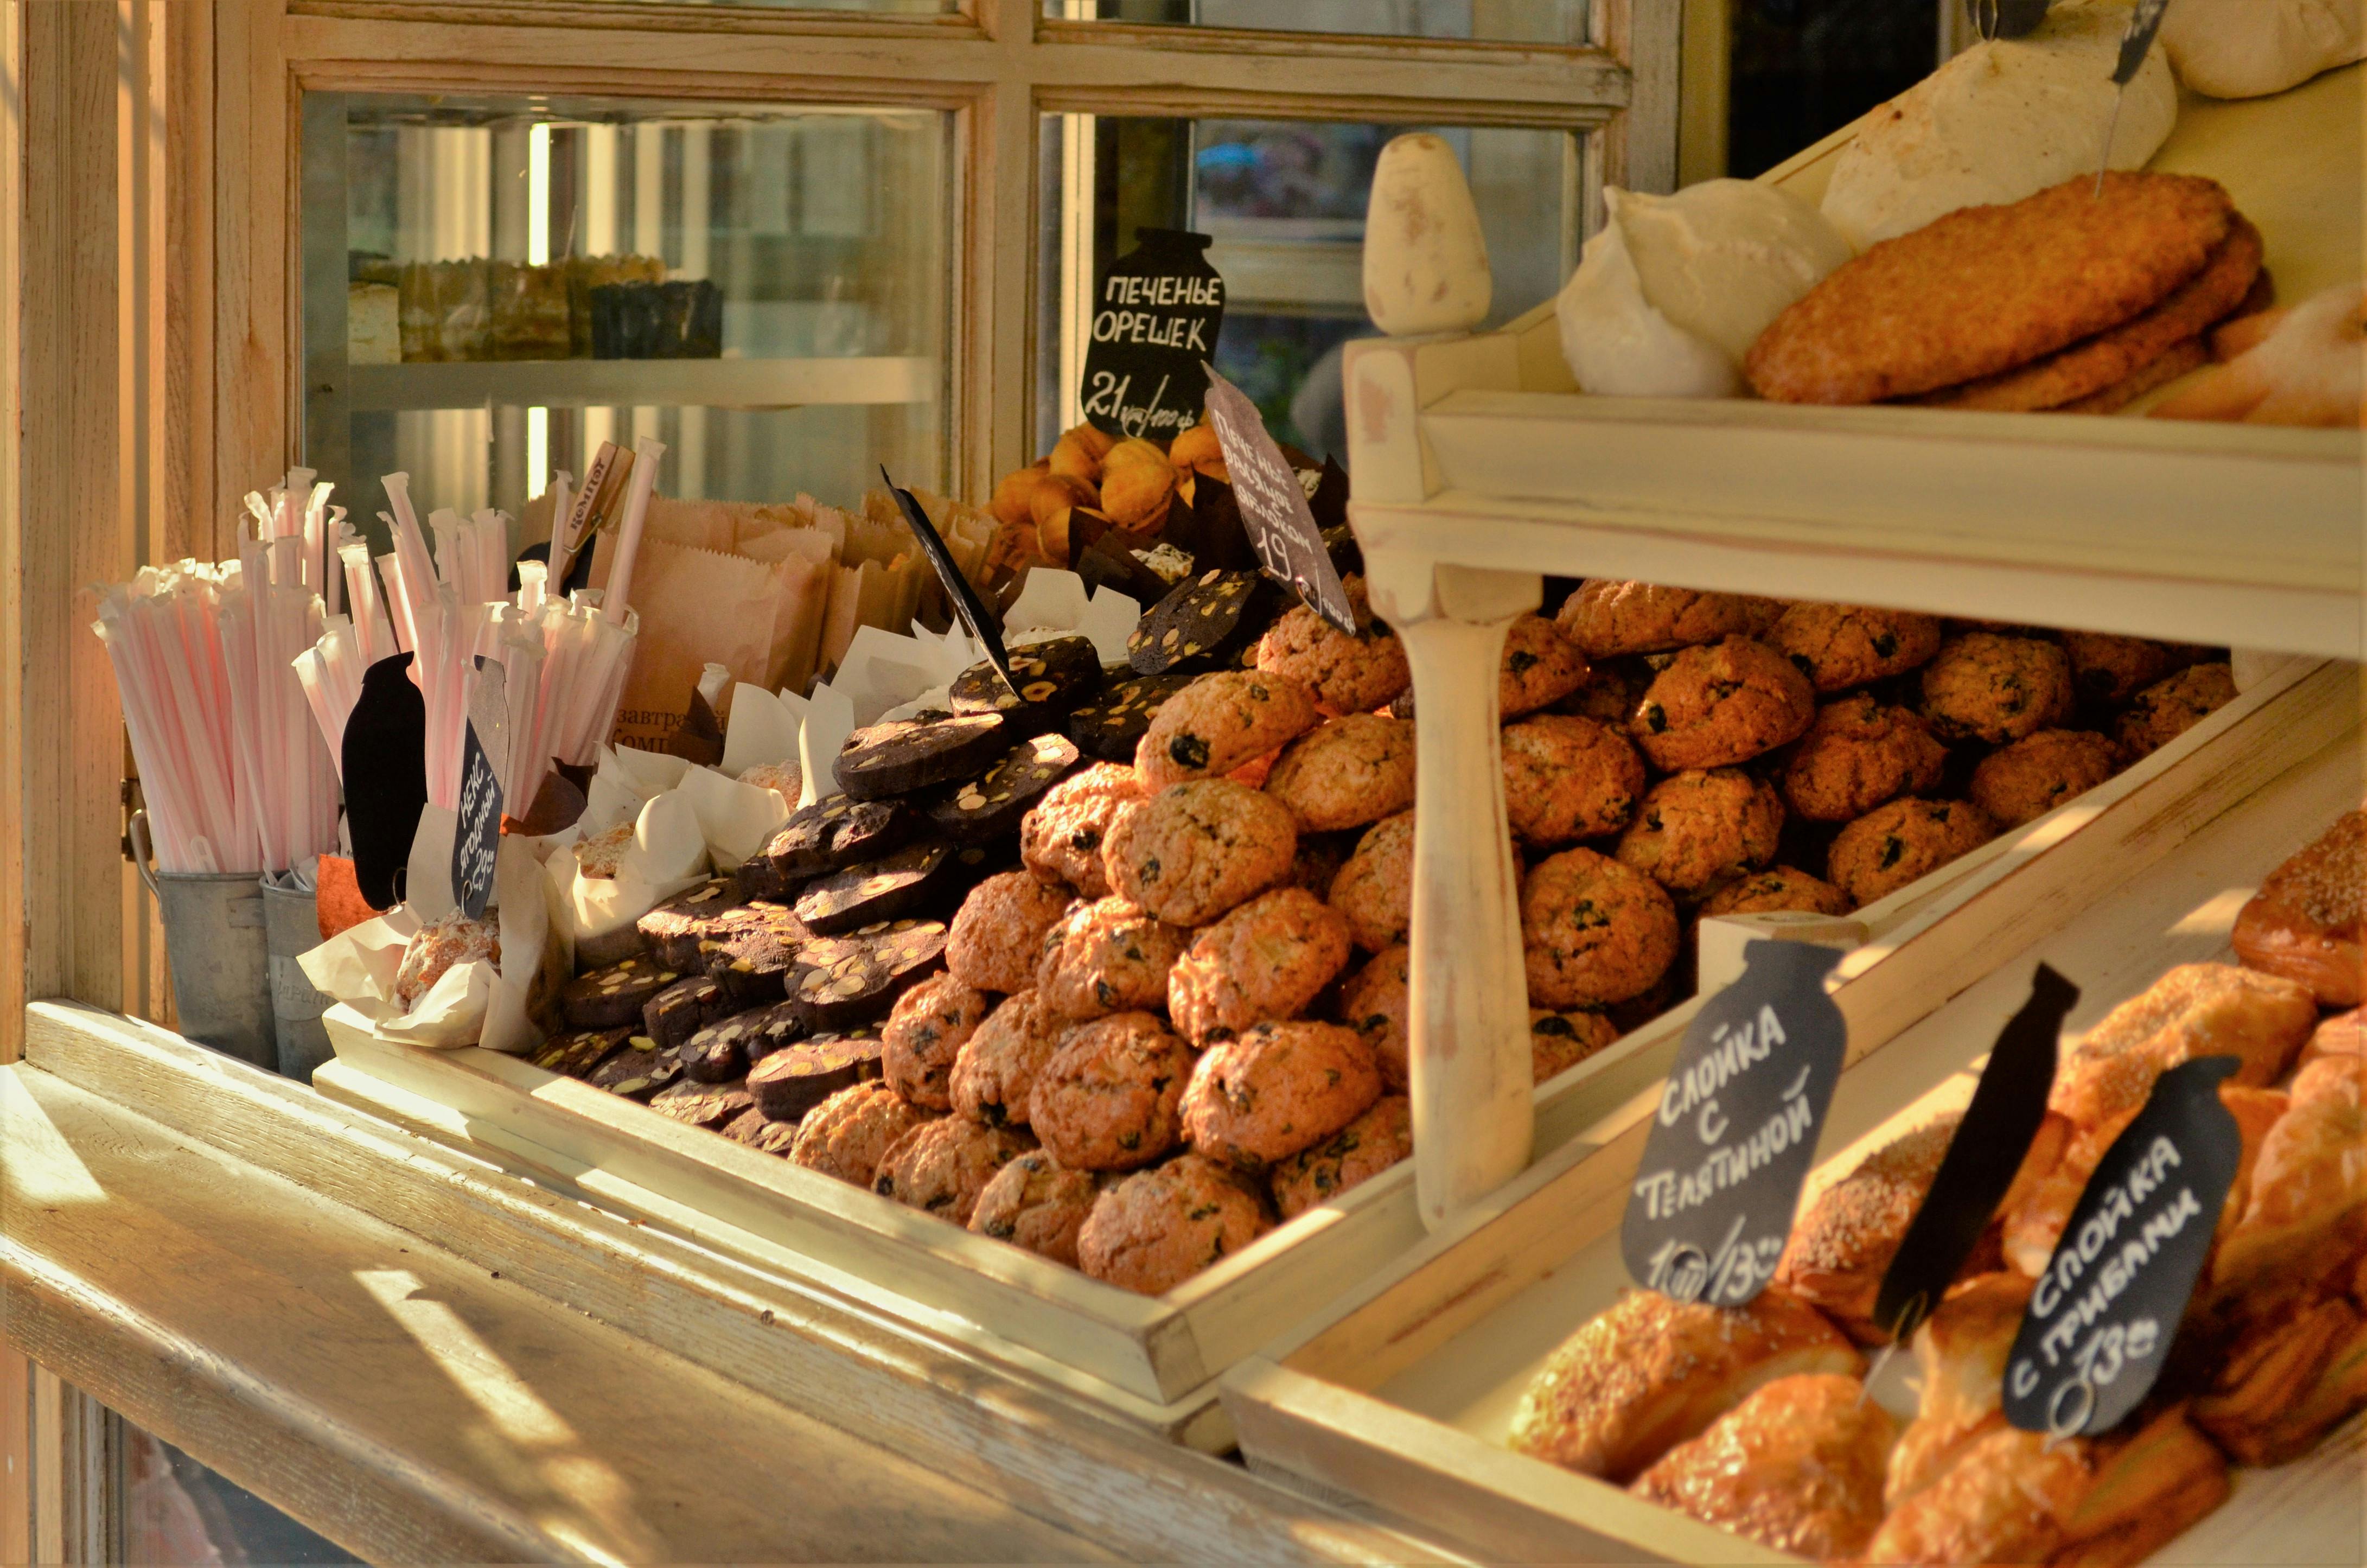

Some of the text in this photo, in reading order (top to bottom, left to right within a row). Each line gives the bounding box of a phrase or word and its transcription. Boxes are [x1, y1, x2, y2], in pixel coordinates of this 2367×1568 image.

[1105, 276, 1223, 306] ПЕЧЕНЬЕ
[1093, 310, 1207, 352] ОРЕШЕК
[570, 457, 604, 531] КОМПОТ
[1237, 484, 1313, 555] ЯБЛОКОМ
[460, 751, 484, 830] КЕКС
[460, 771, 495, 878] ЯГОДНЫЙ
[1658, 1004, 1787, 1129] СЛОЙКА
[2031, 1134, 2183, 1319] СЛОЙКА
[2040, 1187, 2203, 1366] ГРИБАМИ
